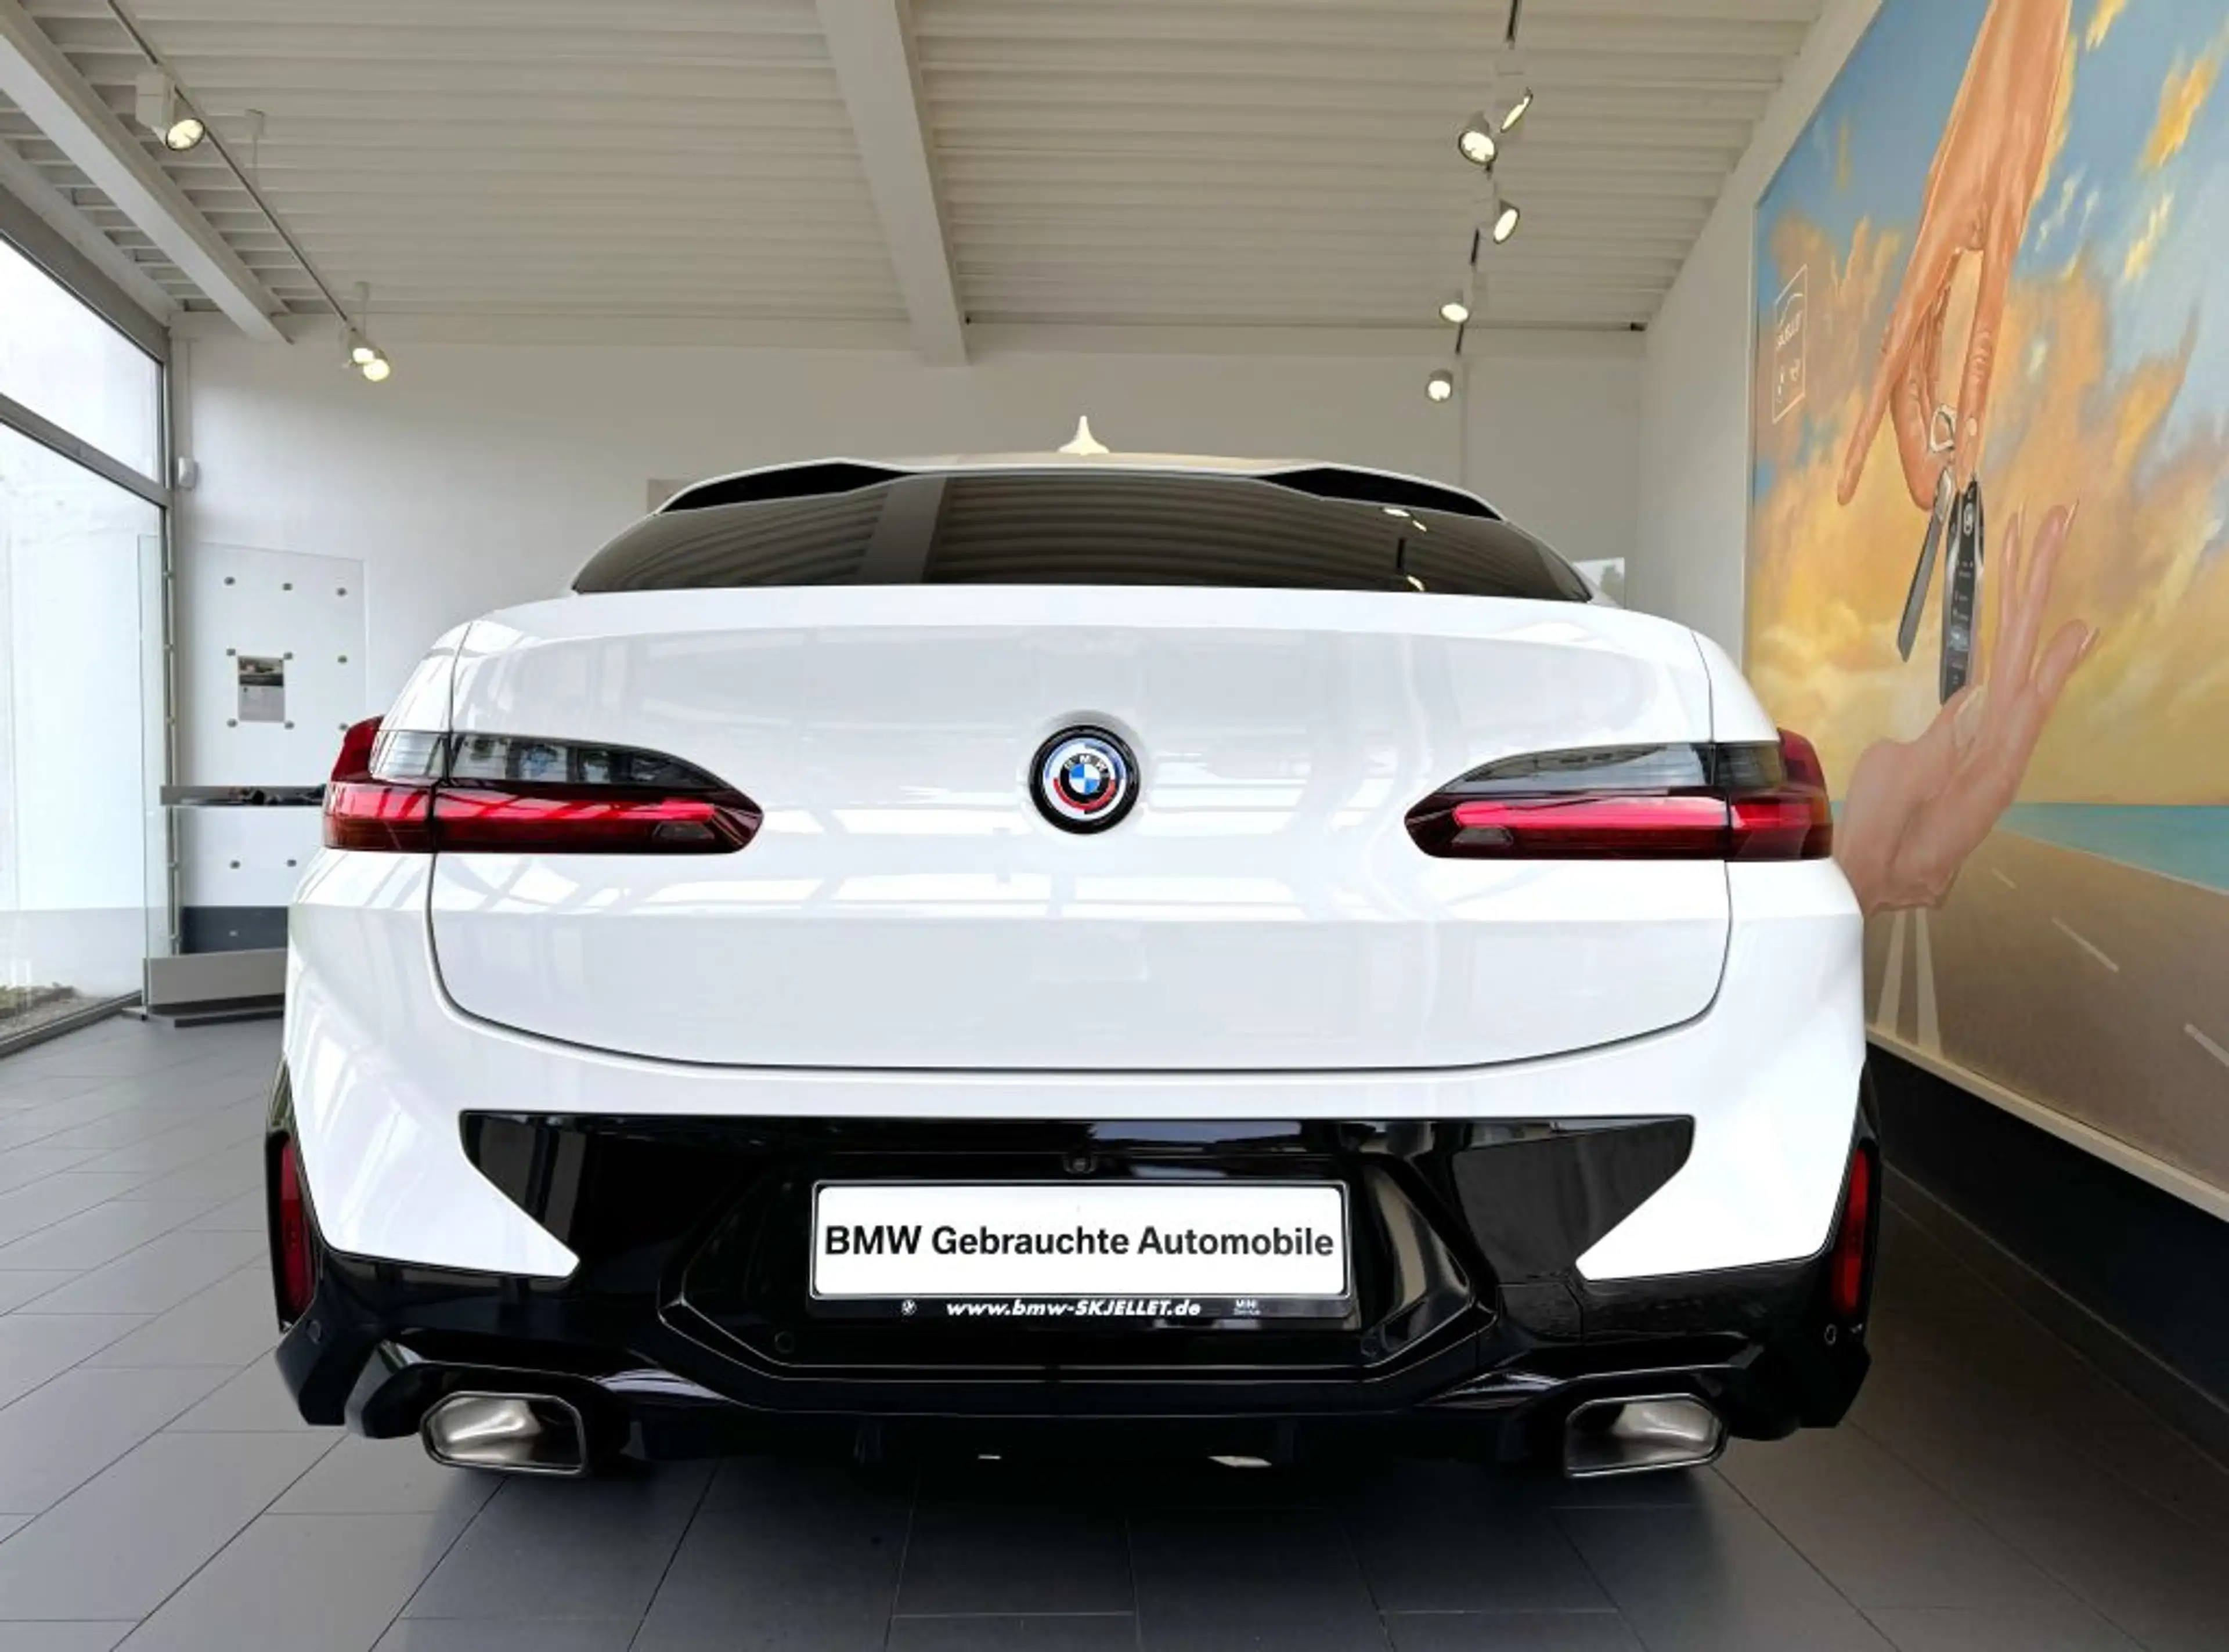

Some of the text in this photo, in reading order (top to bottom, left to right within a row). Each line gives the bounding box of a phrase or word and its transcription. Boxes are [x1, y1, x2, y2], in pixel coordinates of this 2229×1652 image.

[825, 1225, 1334, 1255] BMW Gebrauchte Automobile
[946, 1299, 1201, 1316] www.bmw-SKJELLET.de
